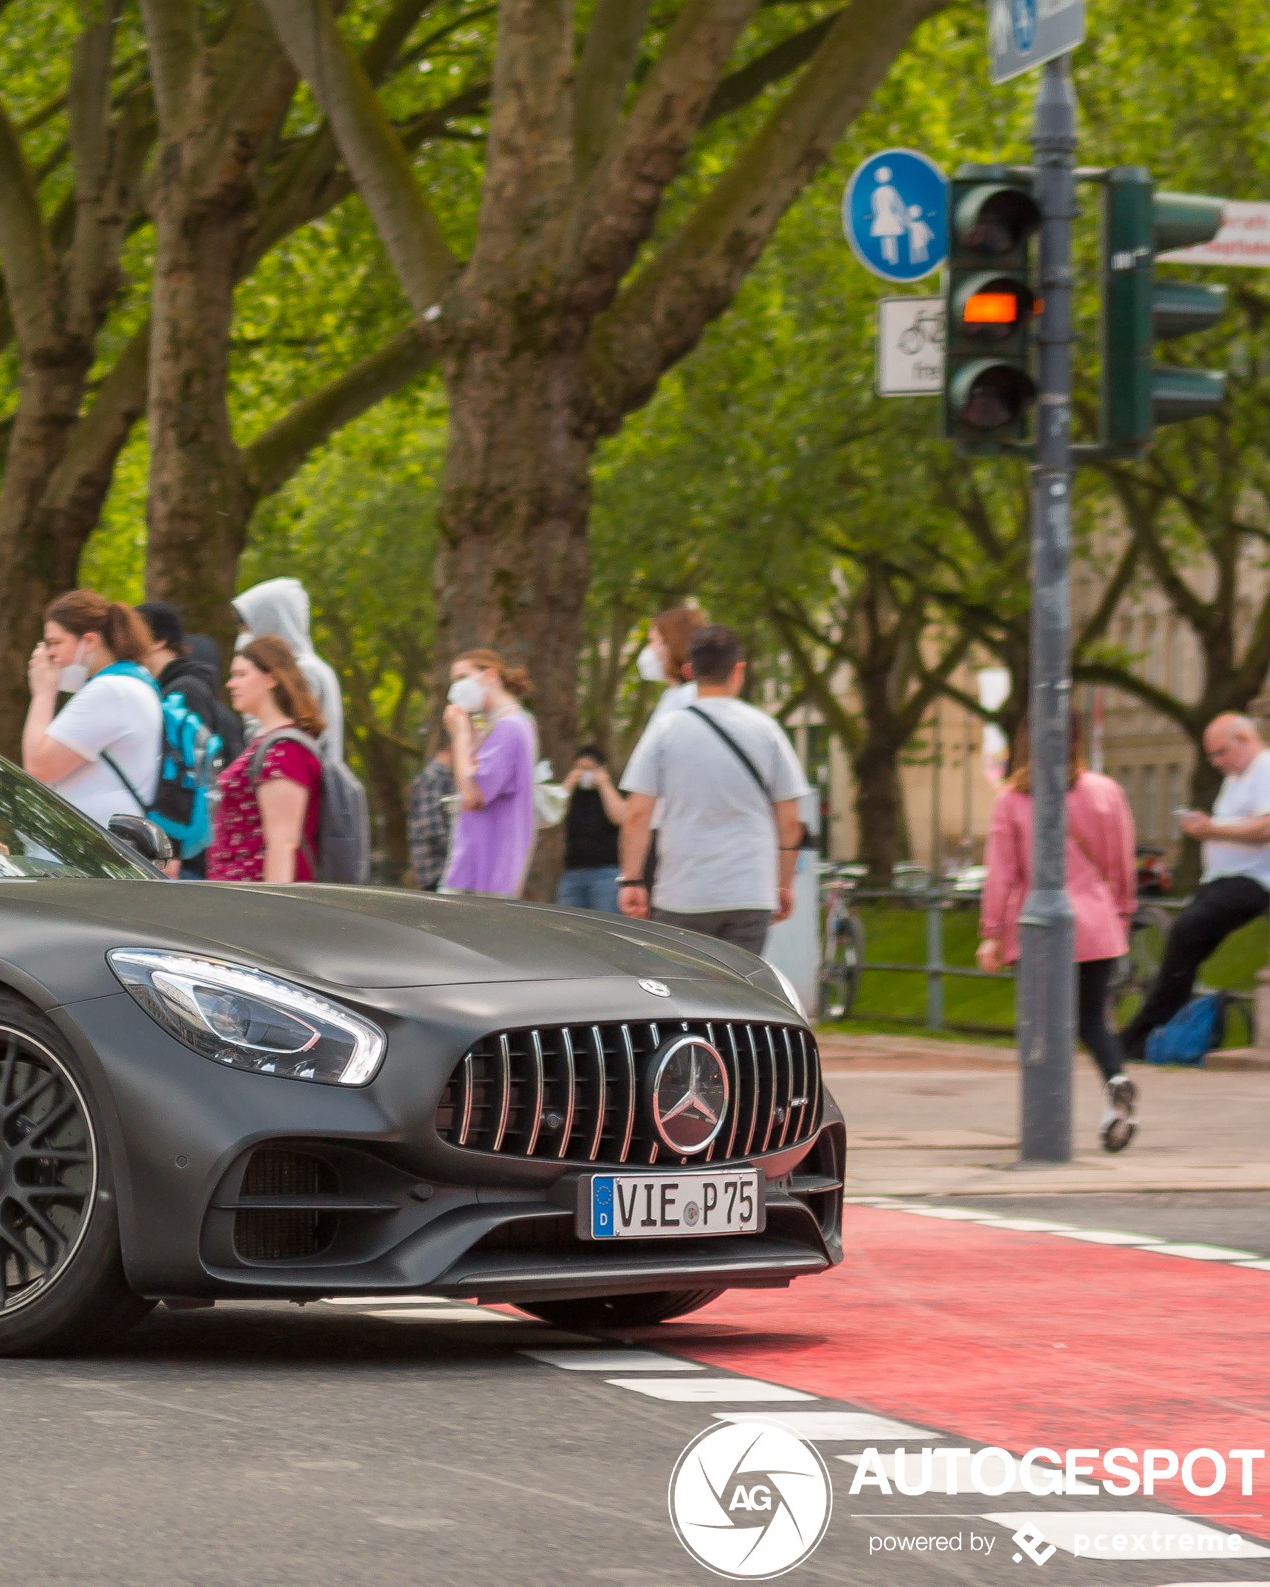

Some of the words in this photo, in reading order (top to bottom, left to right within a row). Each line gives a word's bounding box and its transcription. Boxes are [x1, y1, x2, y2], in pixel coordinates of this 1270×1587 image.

[912, 361, 942, 381] fre
[616, 1183, 679, 1227] VIE
[599, 1212, 608, 1227] D
